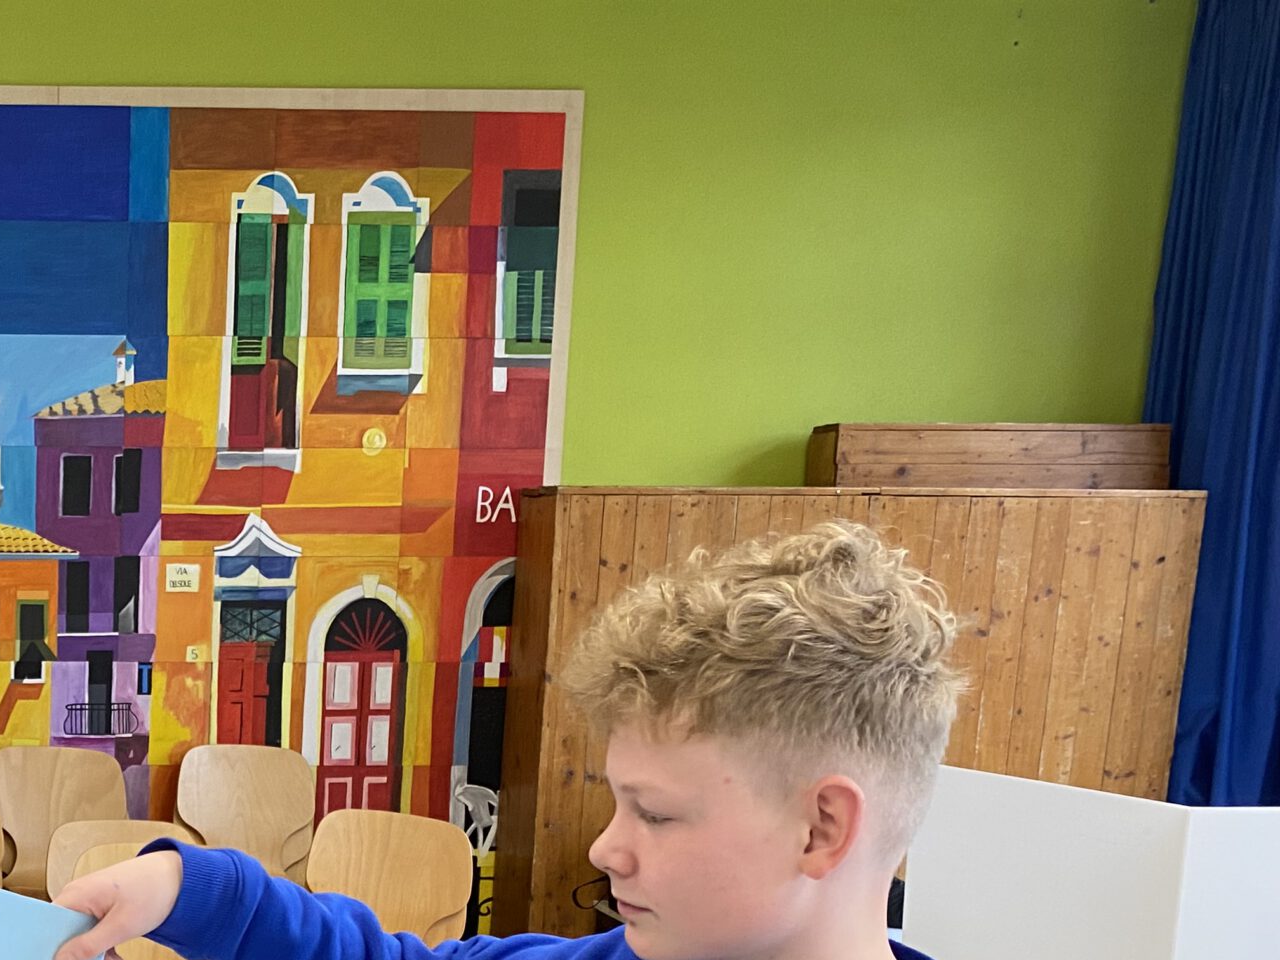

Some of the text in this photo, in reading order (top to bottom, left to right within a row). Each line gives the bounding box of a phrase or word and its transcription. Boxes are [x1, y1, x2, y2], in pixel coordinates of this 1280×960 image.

[476, 486, 516, 523] BA
[175, 567, 188, 576] VIA
[191, 649, 199, 660] 5
